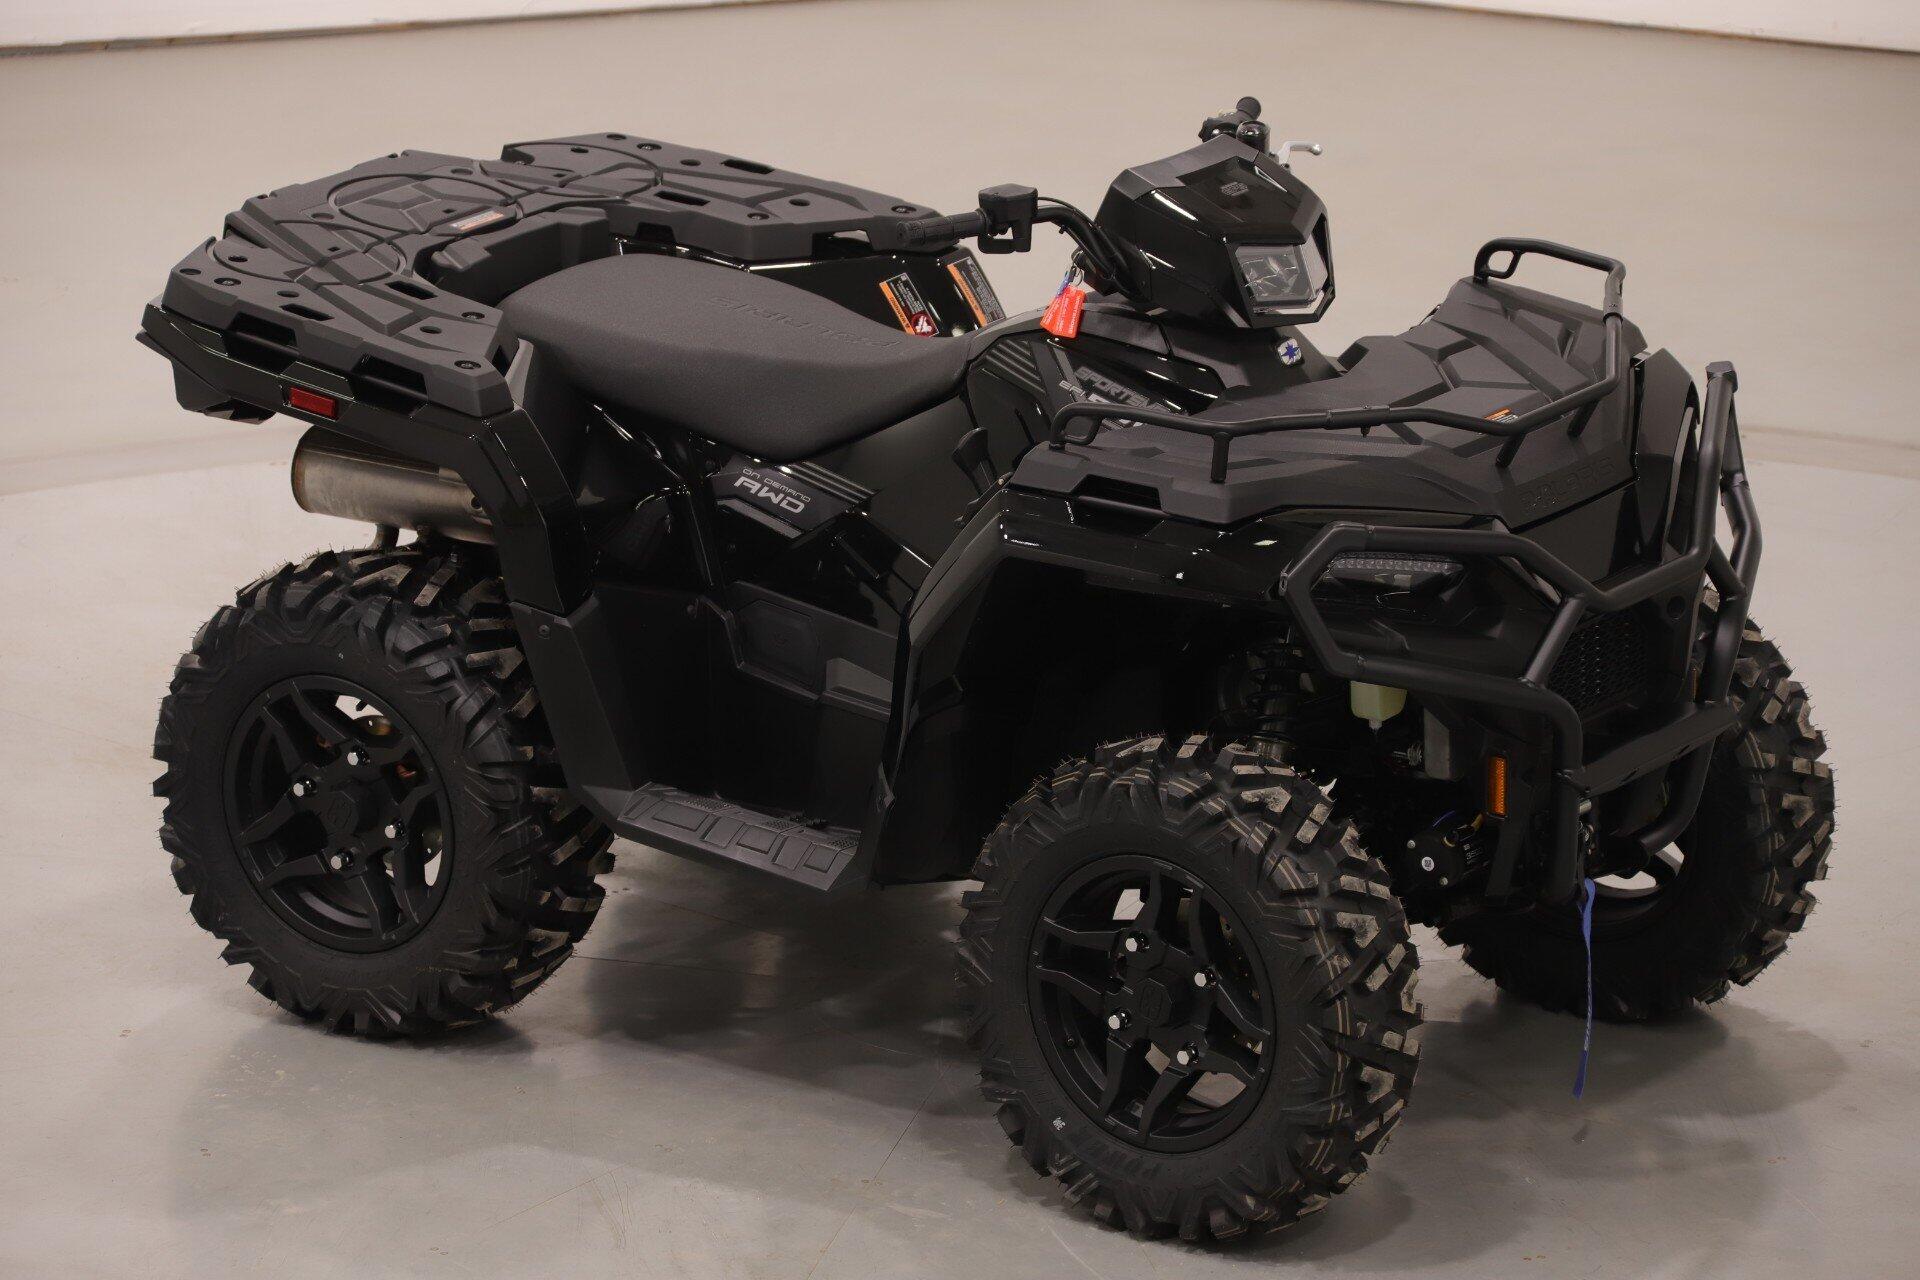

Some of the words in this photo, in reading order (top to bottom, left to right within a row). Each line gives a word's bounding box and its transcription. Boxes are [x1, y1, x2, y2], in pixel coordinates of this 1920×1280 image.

[889, 296, 908, 324] WARNING
[733, 476, 805, 513] AWD
[763, 477, 811, 503] DEMAND
